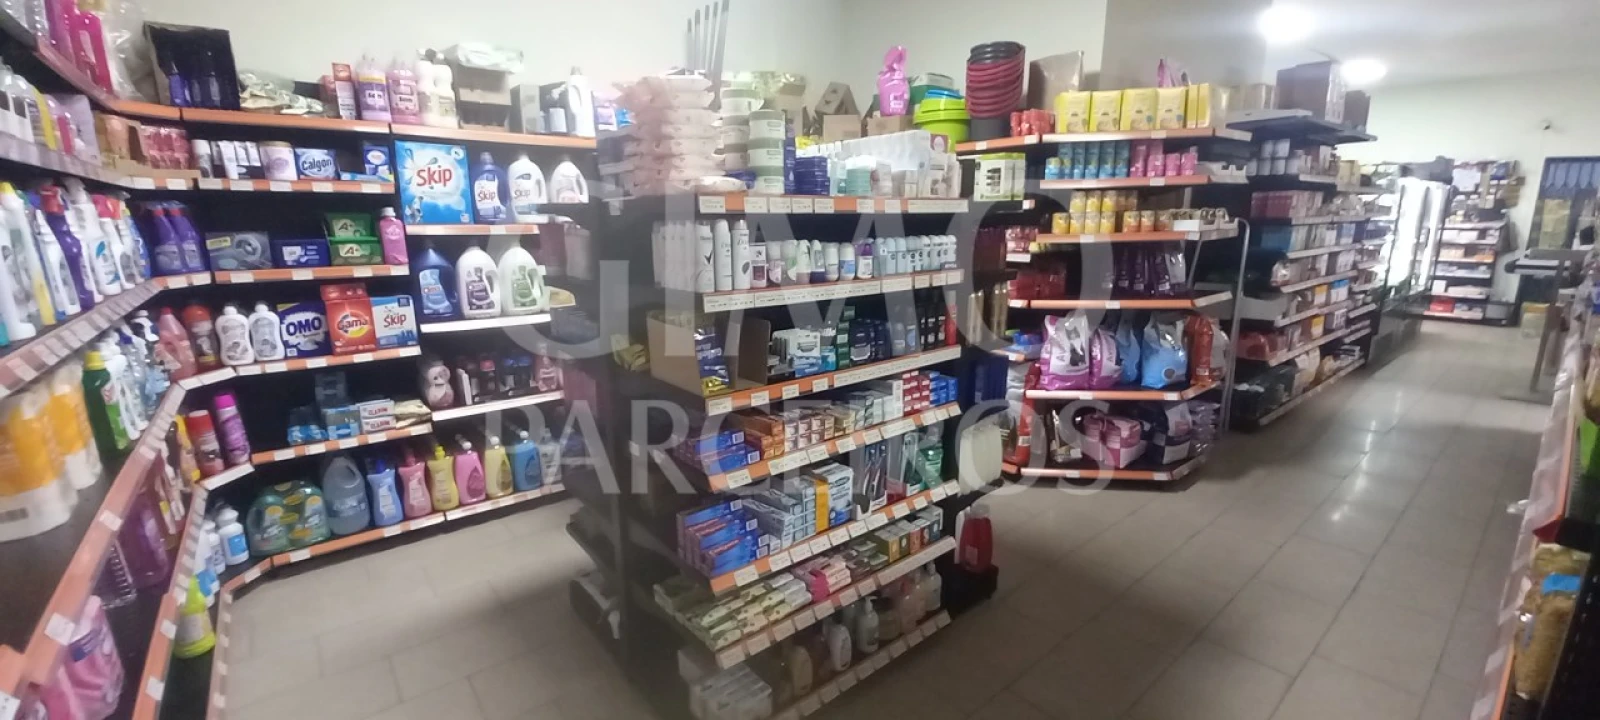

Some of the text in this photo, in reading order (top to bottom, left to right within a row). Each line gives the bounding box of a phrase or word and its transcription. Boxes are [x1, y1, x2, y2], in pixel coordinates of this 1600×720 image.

[301, 157, 332, 172] Calgon
[416, 165, 453, 187] Skip
[478, 189, 496, 202] Skip
[285, 316, 323, 336] OMO
[337, 318, 368, 331] Gama
[383, 312, 407, 328] Skip
